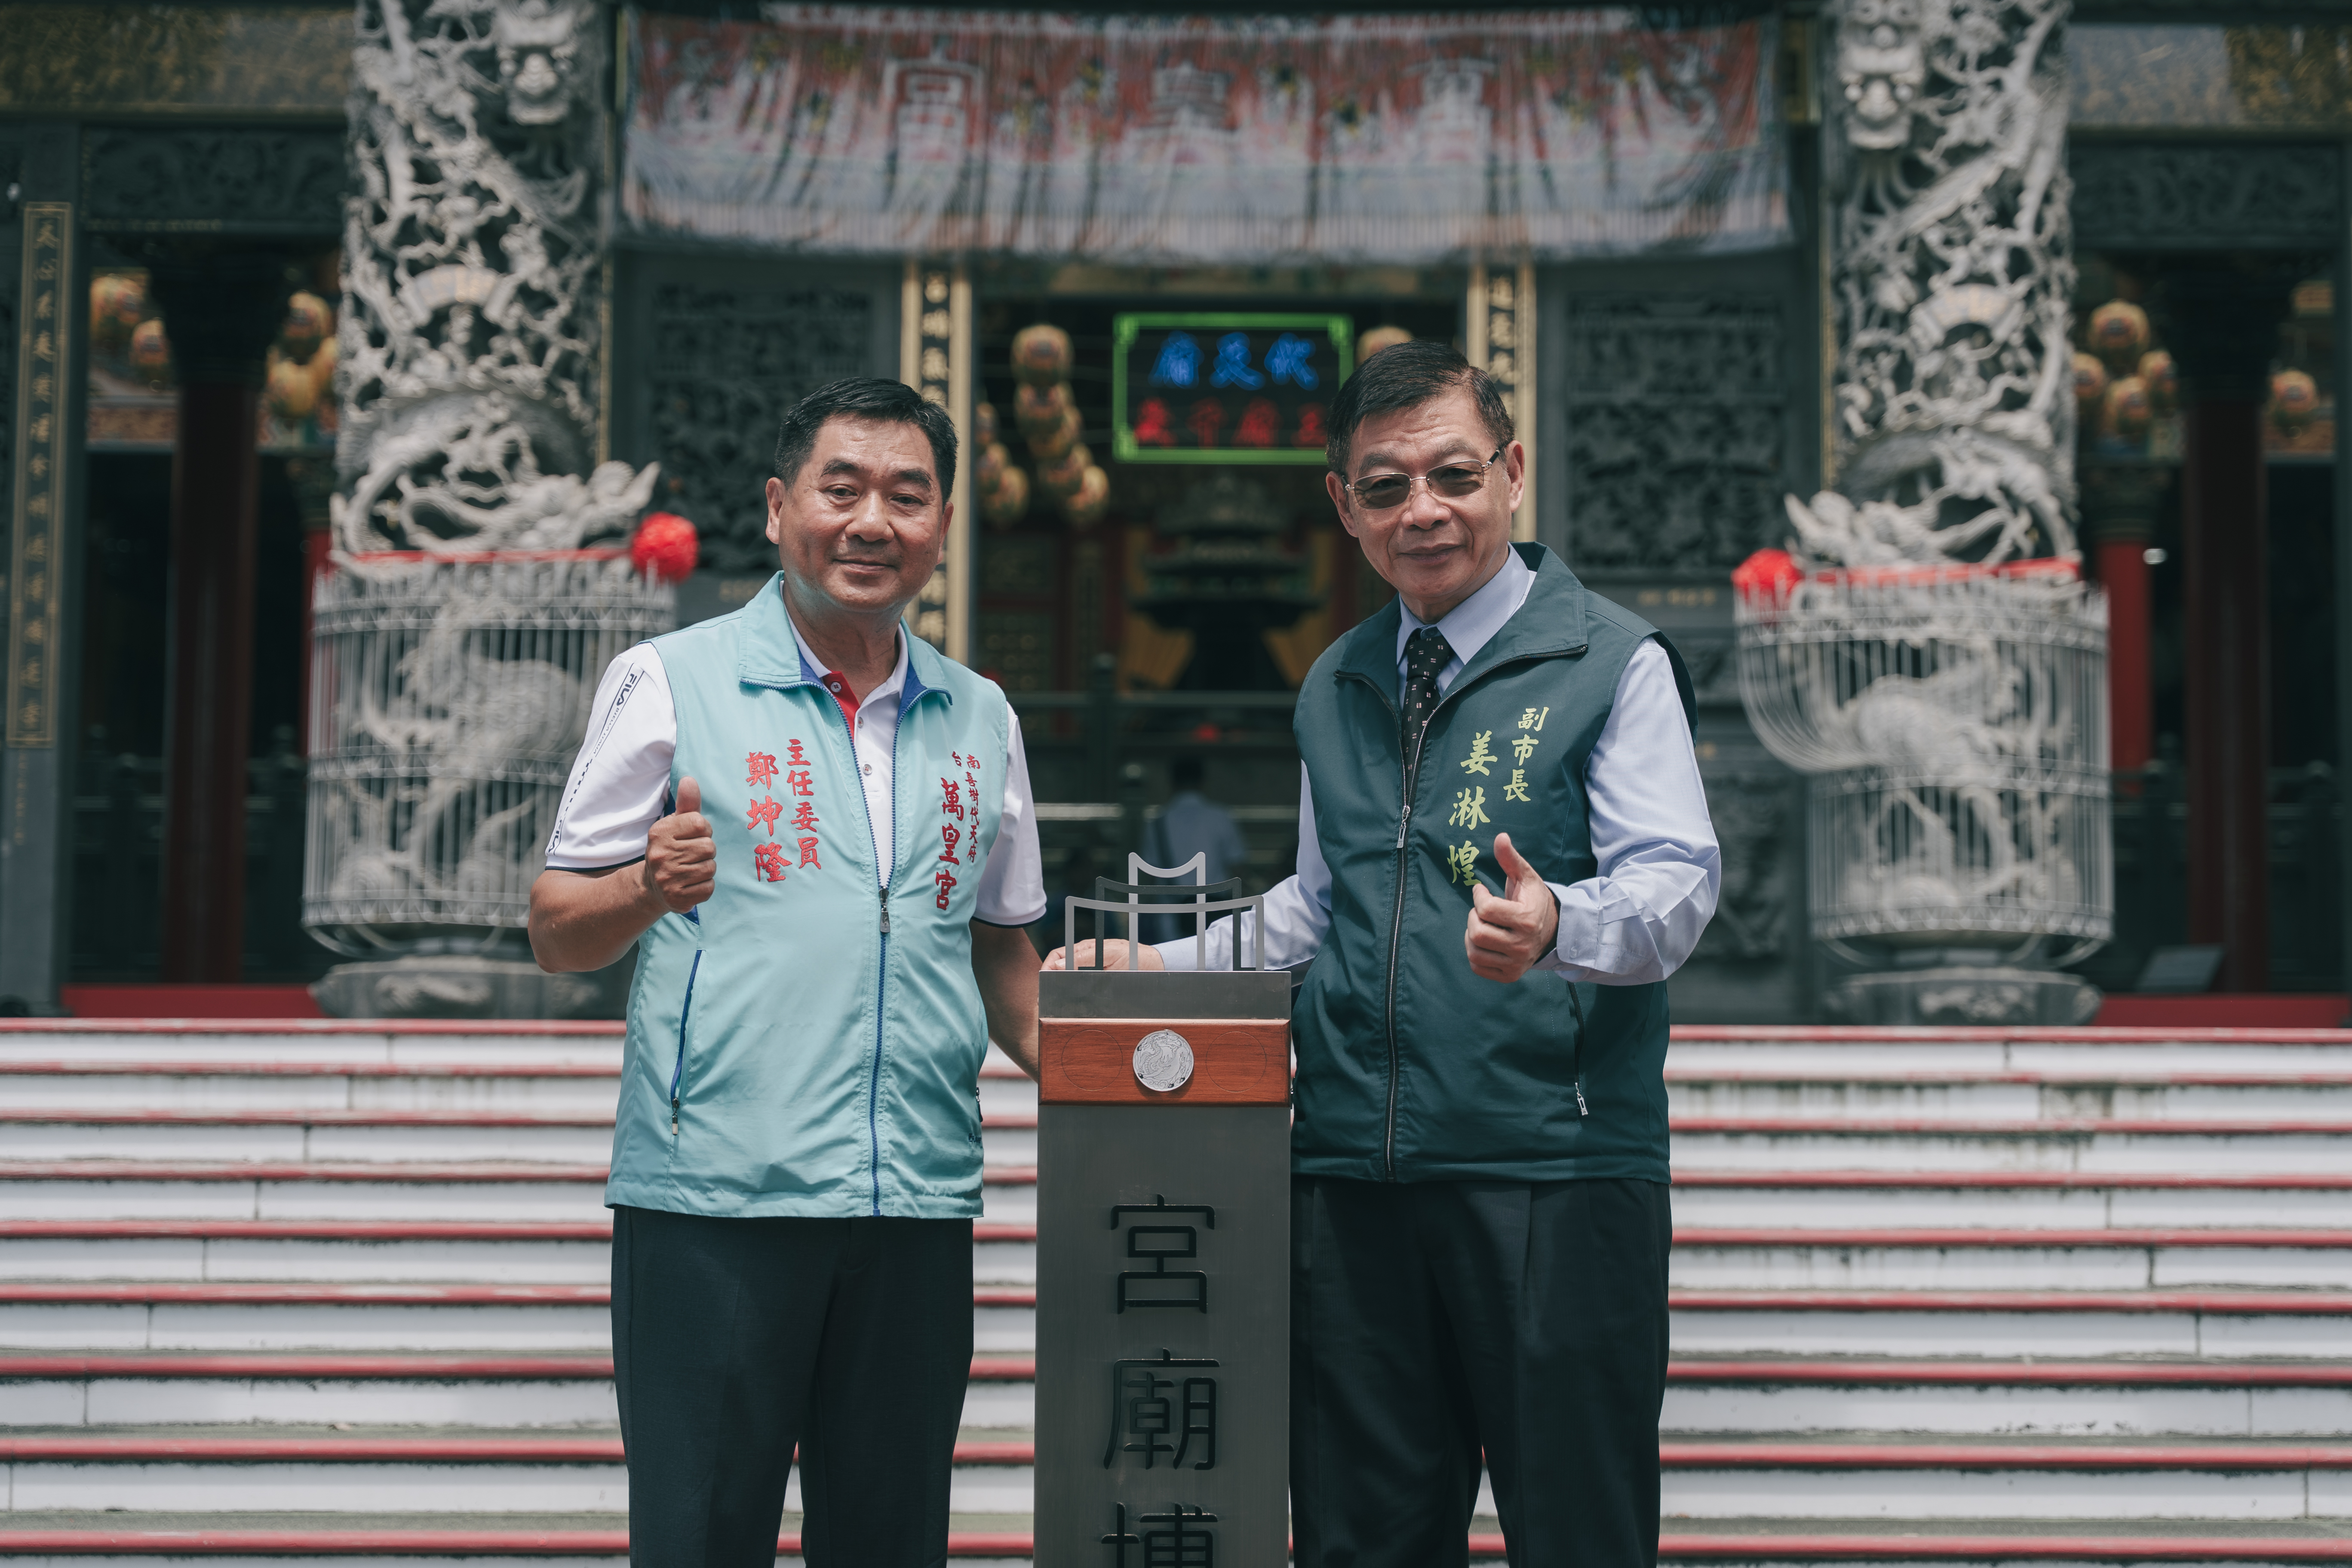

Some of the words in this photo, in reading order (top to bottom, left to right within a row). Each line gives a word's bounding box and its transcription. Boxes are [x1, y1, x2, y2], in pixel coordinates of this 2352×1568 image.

[616, 673, 637, 706] FILA
[1503, 706, 1549, 802] 副市長
[746, 751, 792, 882] 鄭坤隆
[786, 739, 821, 870] 主任委員
[935, 777, 964, 911] 萬皇宮
[1447, 730, 1498, 887] 姜淋煌
